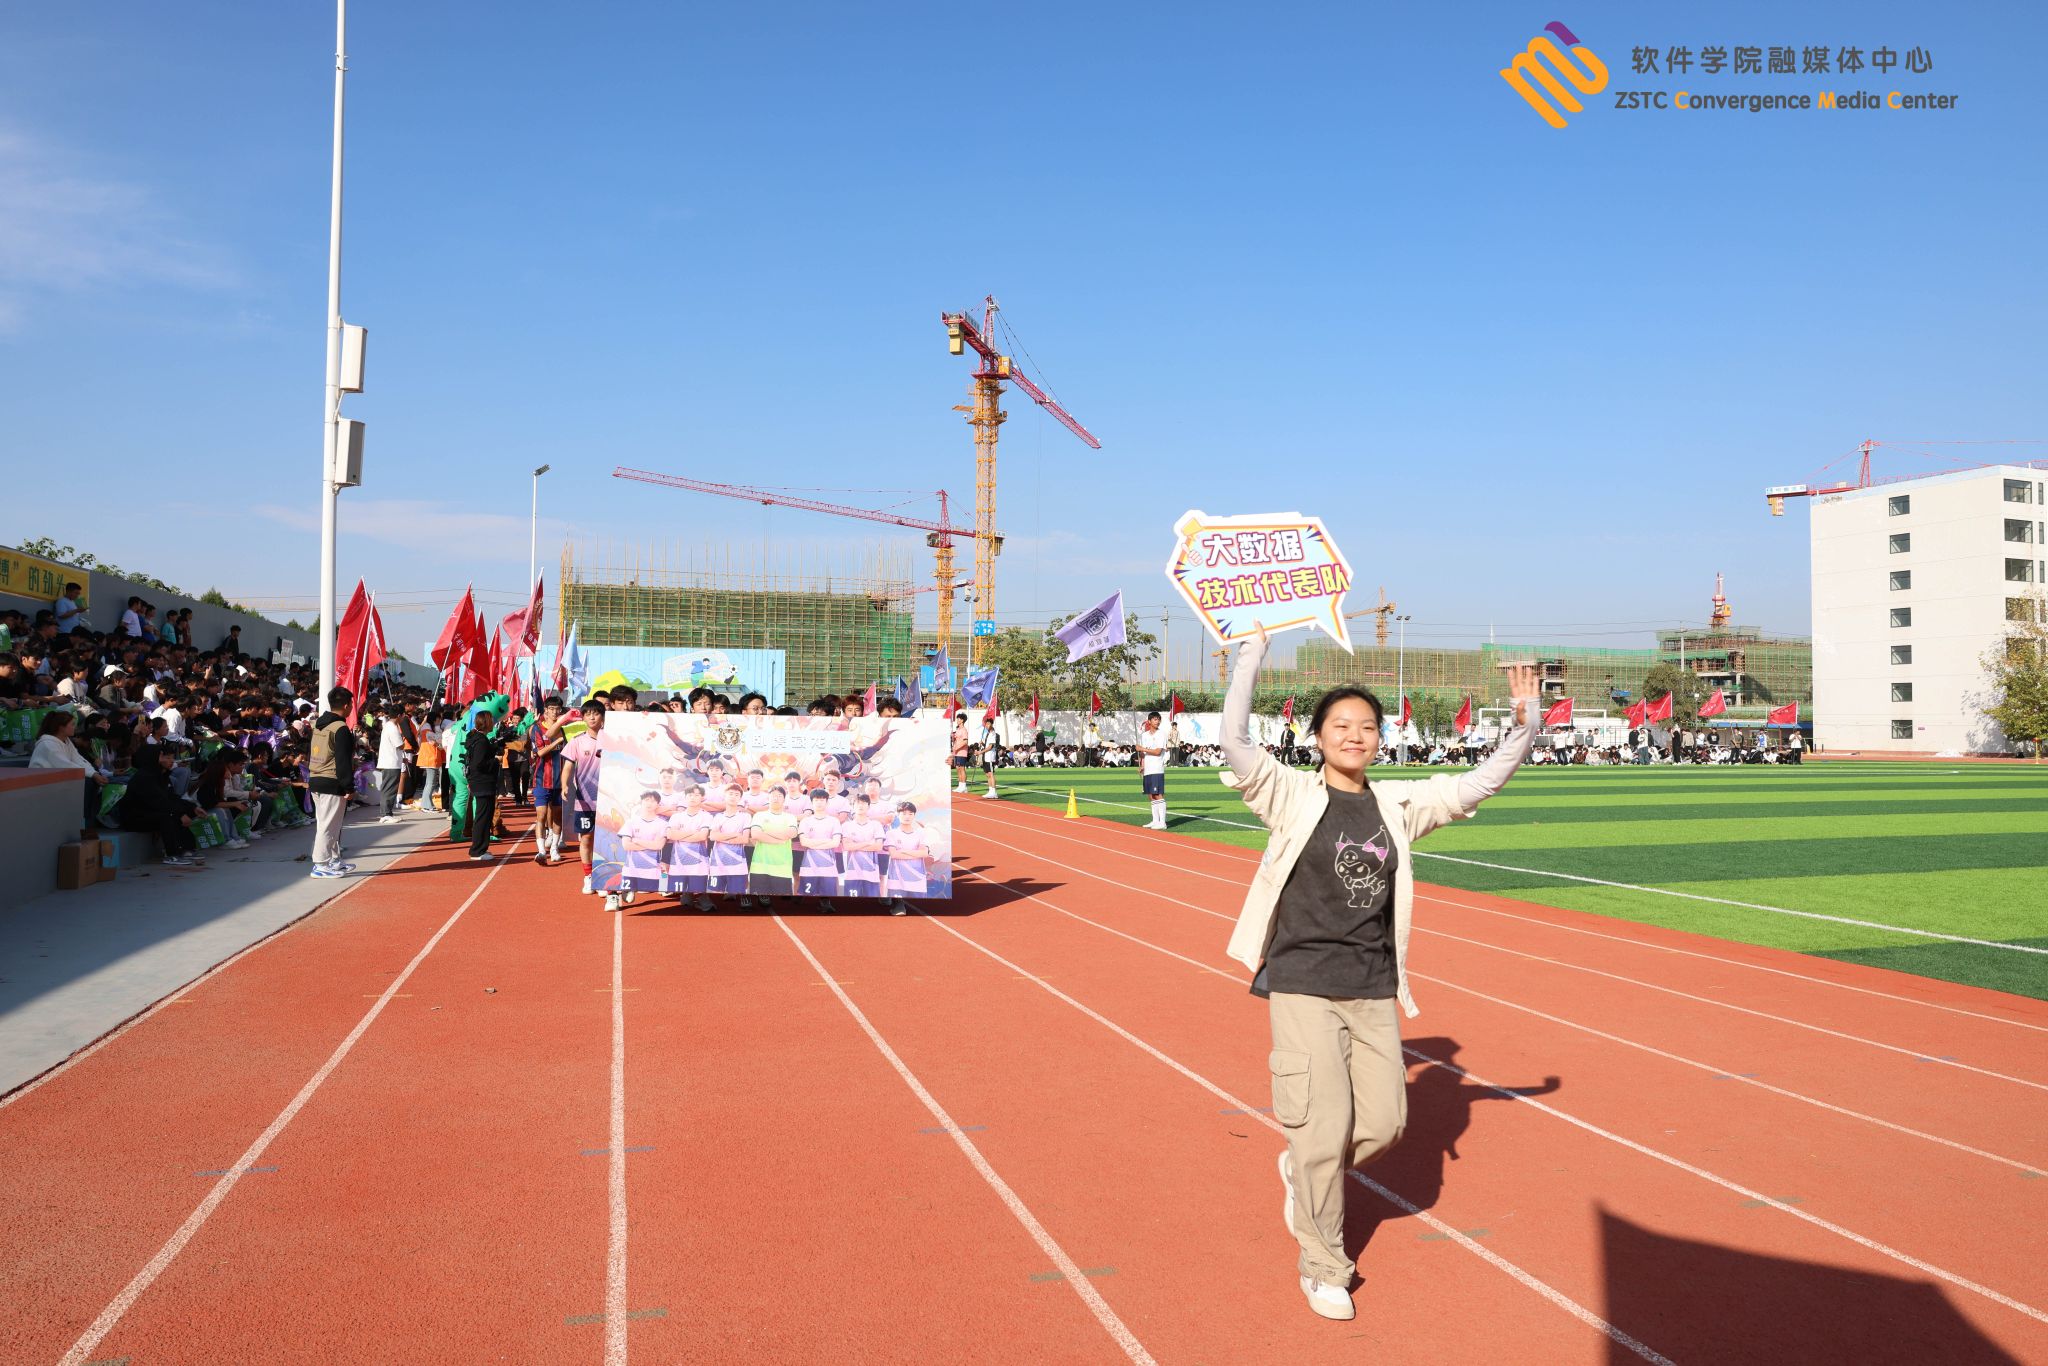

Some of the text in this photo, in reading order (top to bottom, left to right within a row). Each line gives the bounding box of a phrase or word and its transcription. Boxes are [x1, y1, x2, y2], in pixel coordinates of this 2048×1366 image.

[1202, 529, 1304, 567] 大数据
[1197, 564, 1351, 610] 技术代表队
[580, 817, 591, 829] 15
[710, 876, 718, 887] 10
[804, 883, 812, 893] 2
